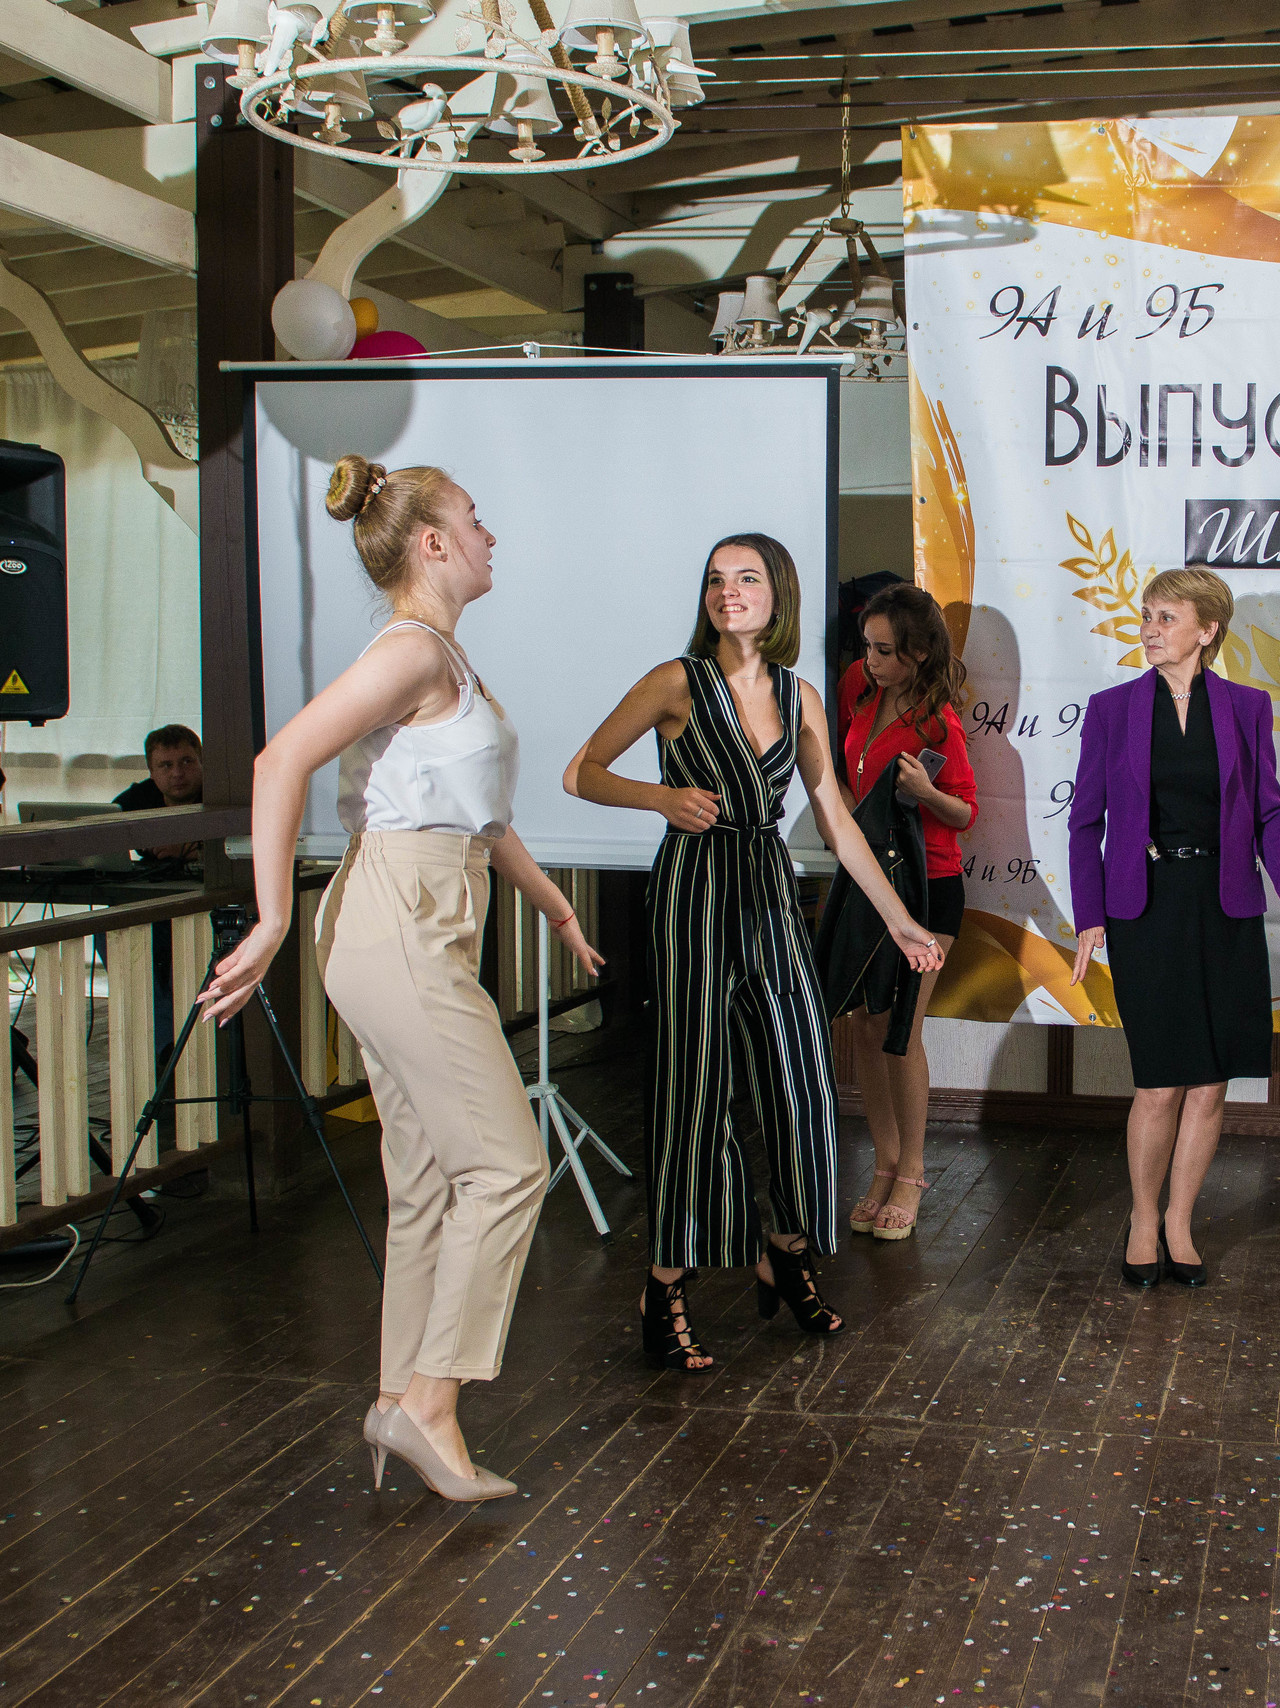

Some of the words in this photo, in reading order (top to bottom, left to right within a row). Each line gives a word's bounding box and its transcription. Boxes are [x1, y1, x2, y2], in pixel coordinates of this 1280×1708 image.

[979, 285, 1062, 340] 9А
[1077, 304, 1119, 340] и
[1135, 283, 1225, 339] 9Б
[969, 701, 1009, 736] 9А
[1018, 715, 1042, 738] и
[1043, 780, 1075, 819] 9
[981, 864, 998, 882] и
[1004, 858, 1041, 884] 9Б
